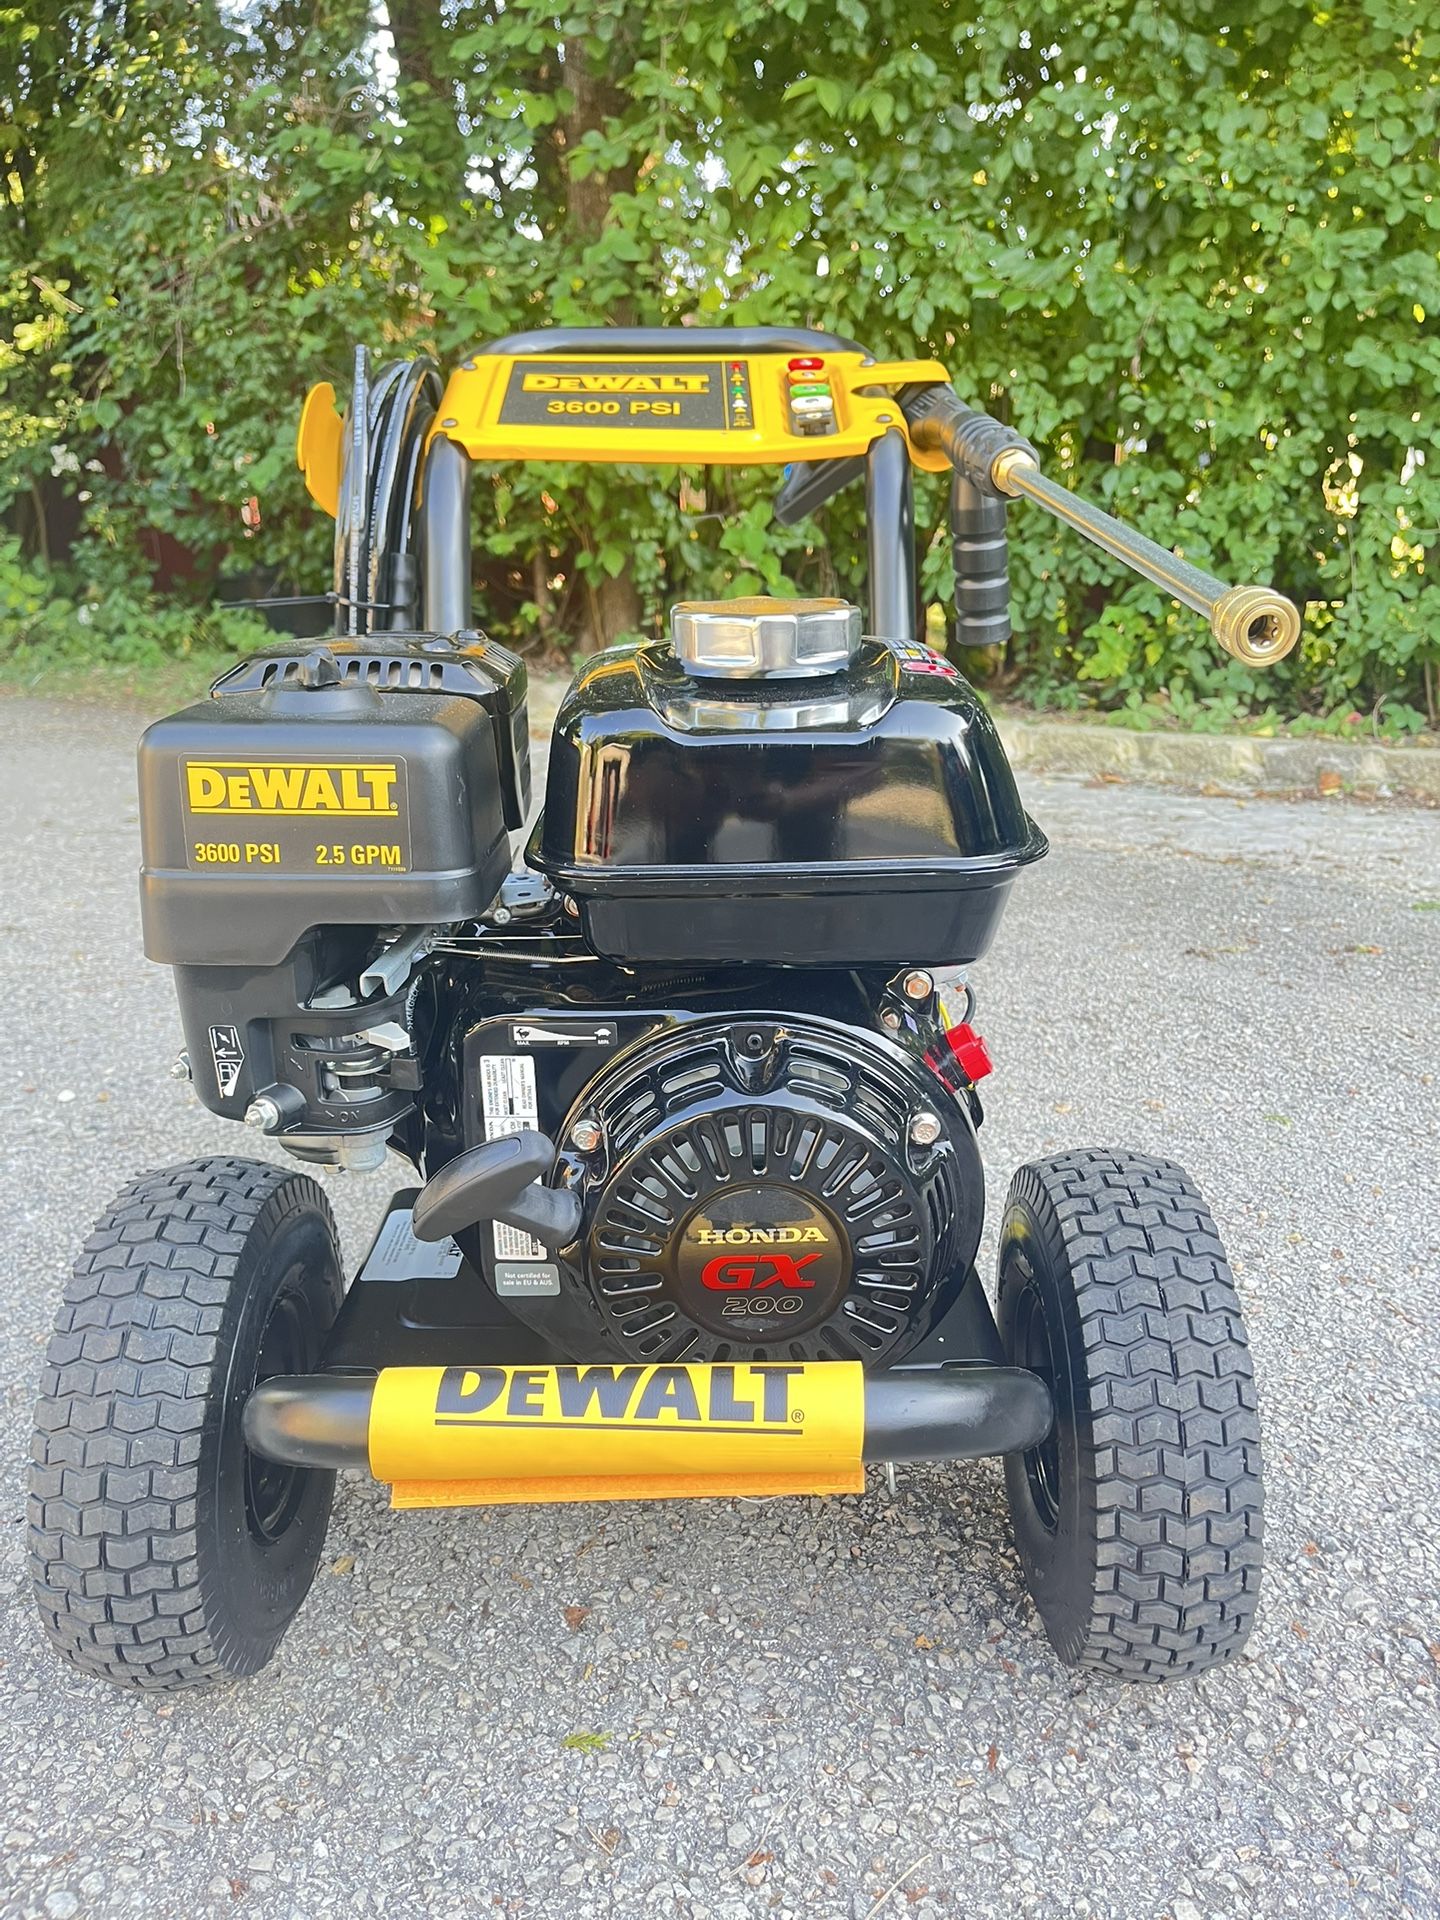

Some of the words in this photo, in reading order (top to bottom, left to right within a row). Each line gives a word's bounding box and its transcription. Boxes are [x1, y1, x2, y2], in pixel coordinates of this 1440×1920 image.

[523, 374, 710, 392] DEWALT
[547, 400, 620, 415] 3600
[629, 401, 681, 415] PSI
[187, 766, 398, 811] DEWALT
[194, 843, 240, 863] 3600
[245, 843, 281, 864] PSI
[316, 845, 345, 865] 2.5
[351, 845, 401, 865] GPM
[698, 1227, 829, 1245] HONDA
[702, 1253, 824, 1290] GX
[721, 1295, 804, 1316] 200
[435, 1365, 804, 1423] DEWALT
